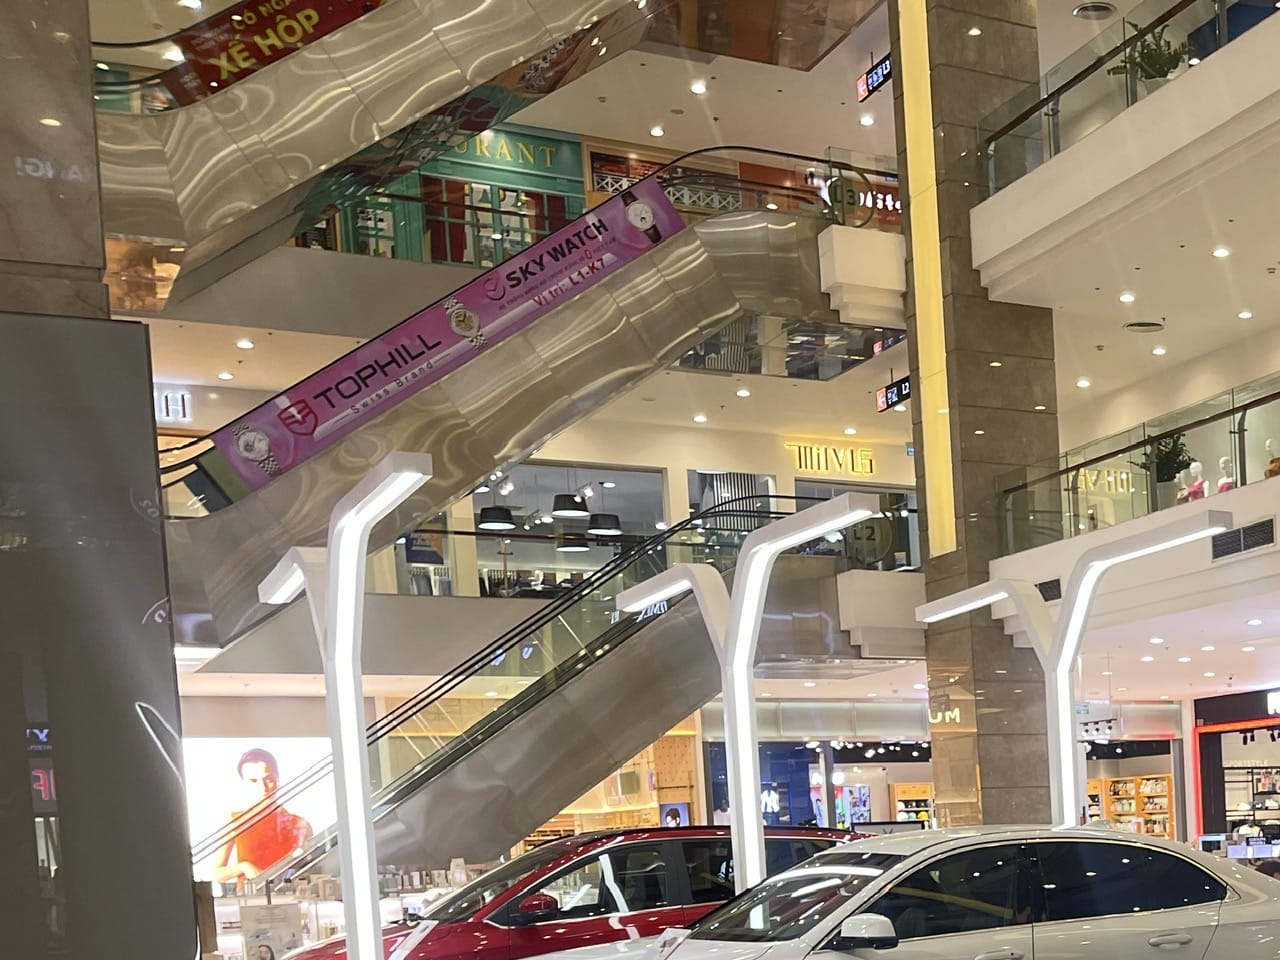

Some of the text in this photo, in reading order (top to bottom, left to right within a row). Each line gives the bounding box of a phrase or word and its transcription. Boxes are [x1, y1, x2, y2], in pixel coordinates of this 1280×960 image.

[253, 8, 320, 56] HỘP
[506, 252, 545, 289] SKY
[546, 218, 609, 263] WATCH
[313, 334, 442, 409] TOPHILL
[350, 361, 434, 414] Swiss Brand
[853, 526, 876, 541] L2
